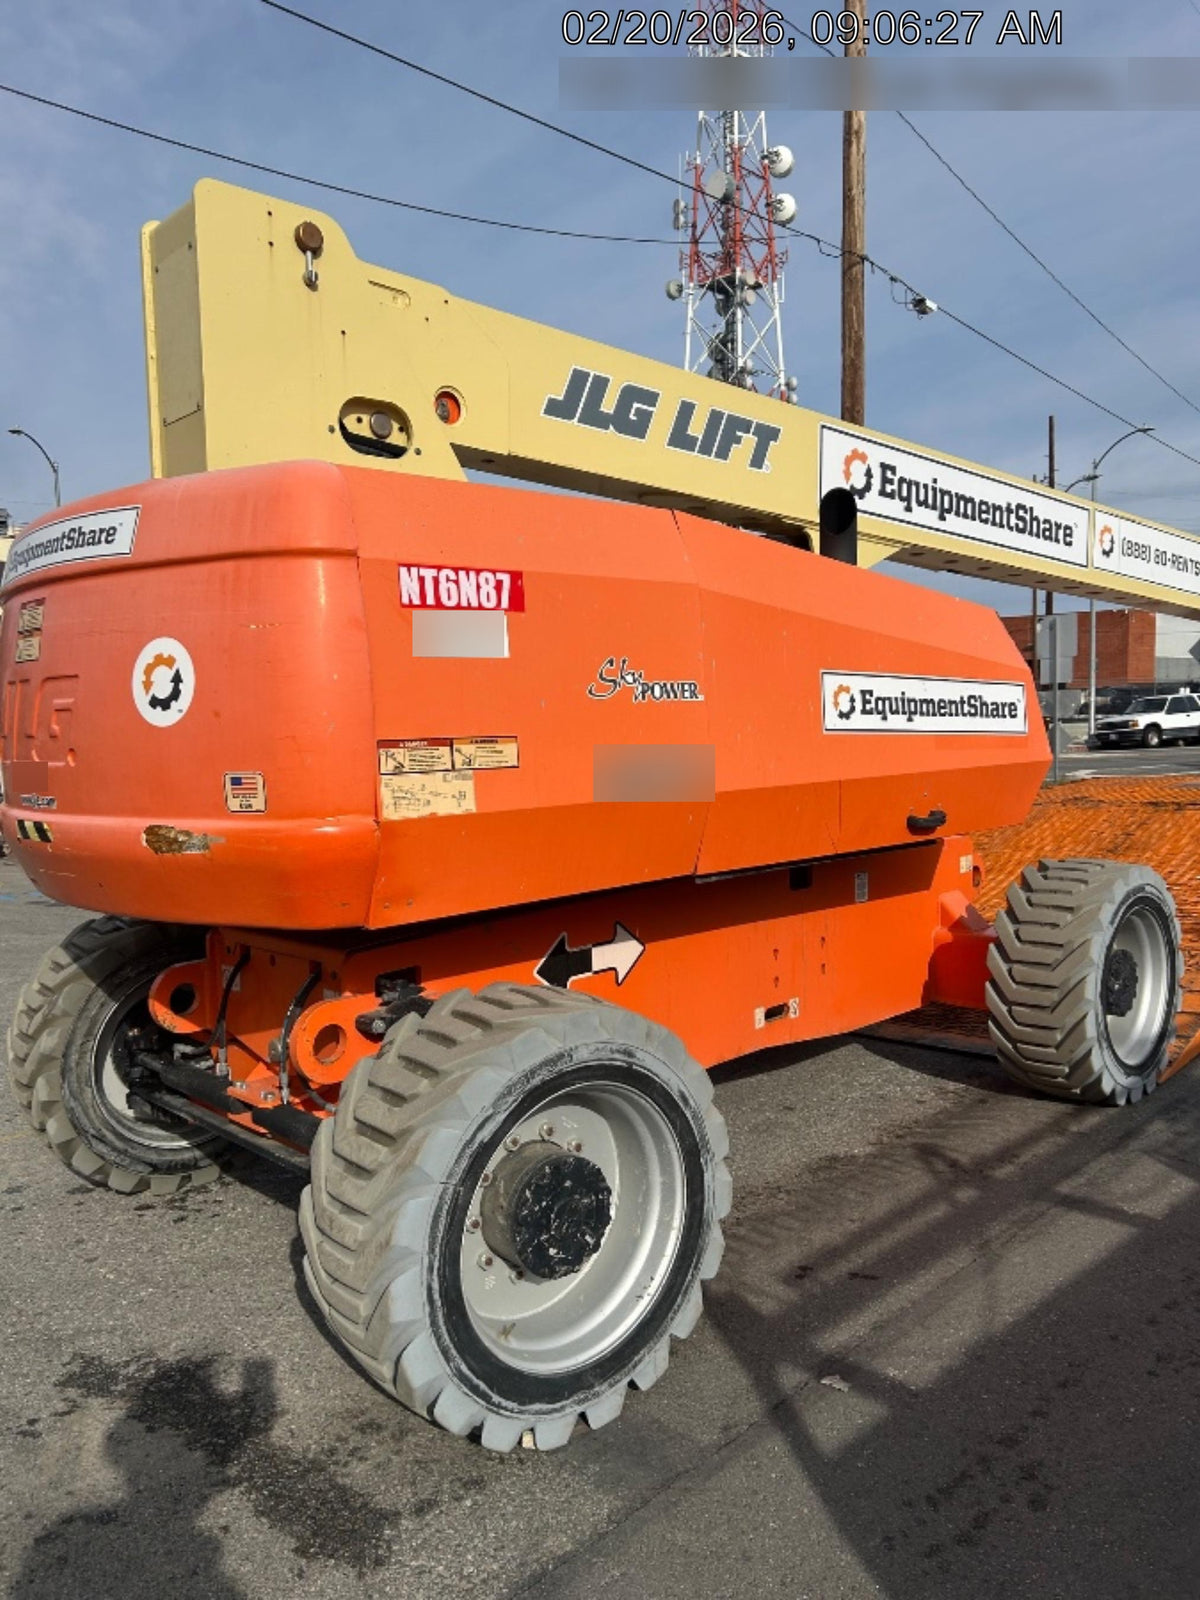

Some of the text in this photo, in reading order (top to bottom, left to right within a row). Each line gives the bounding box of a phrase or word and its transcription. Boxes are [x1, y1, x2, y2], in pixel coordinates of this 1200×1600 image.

[541, 365, 783, 473] JLG LIFT
[878, 461, 1074, 547] EquipmentShare
[398, 566, 511, 609] NT6N87
[860, 689, 1019, 722] EquipmentShare
